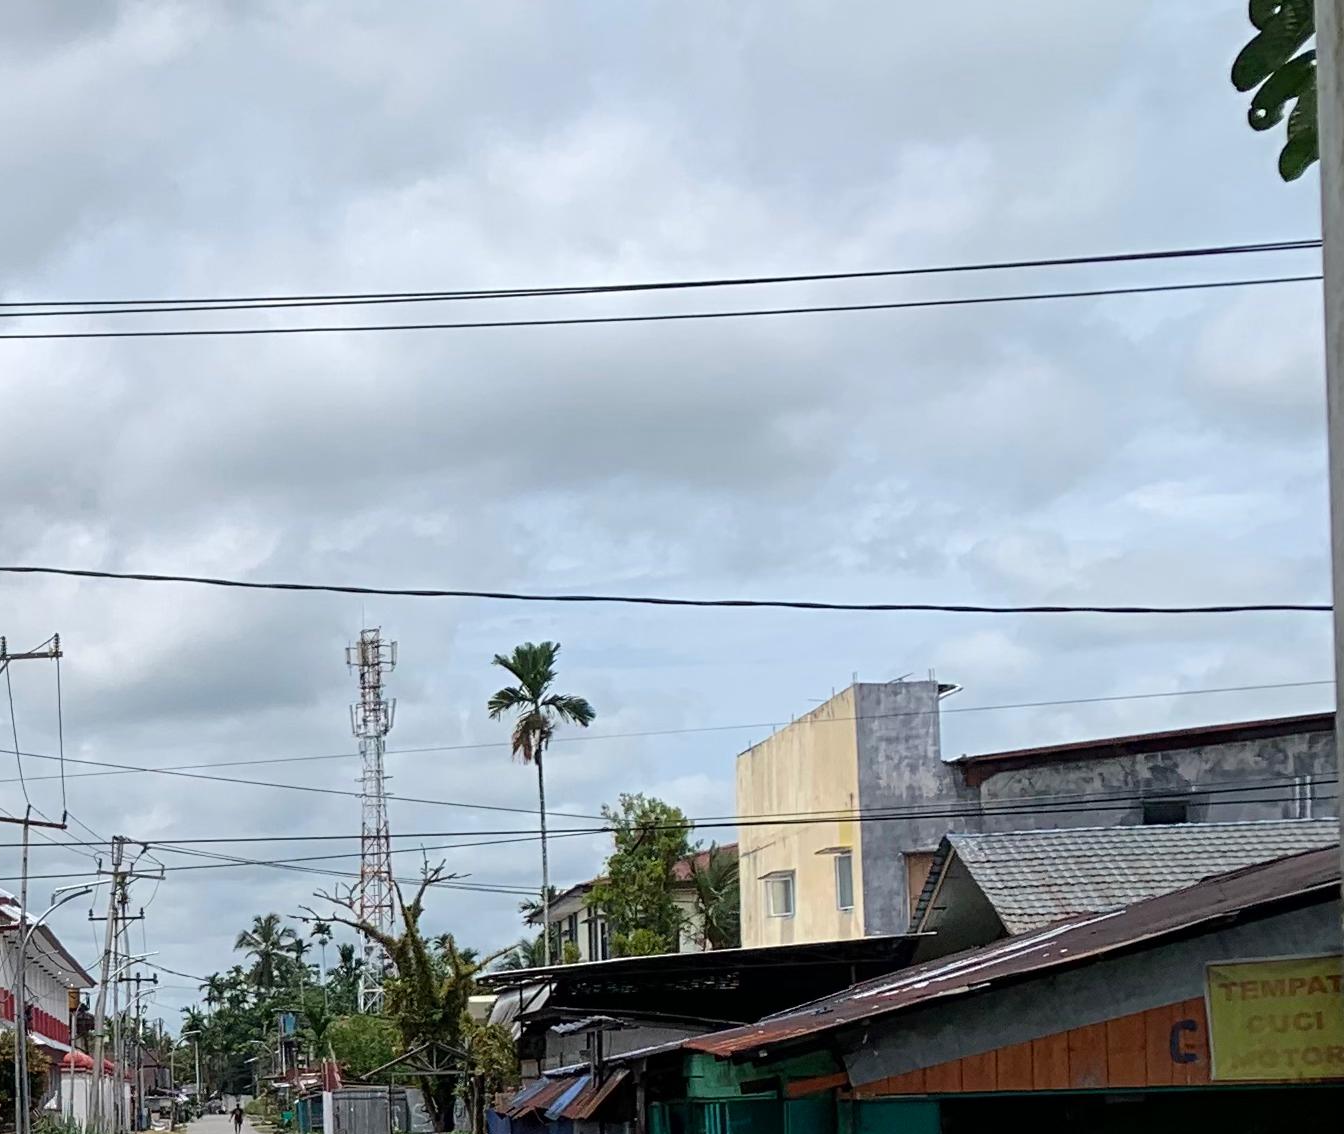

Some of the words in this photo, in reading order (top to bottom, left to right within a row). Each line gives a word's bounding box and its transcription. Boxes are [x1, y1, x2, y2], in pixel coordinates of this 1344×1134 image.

[1217, 974, 1342, 1002] TEMPAT
[1246, 1010, 1325, 1033] CUCI
[1230, 1044, 1343, 1069] MOTOR
